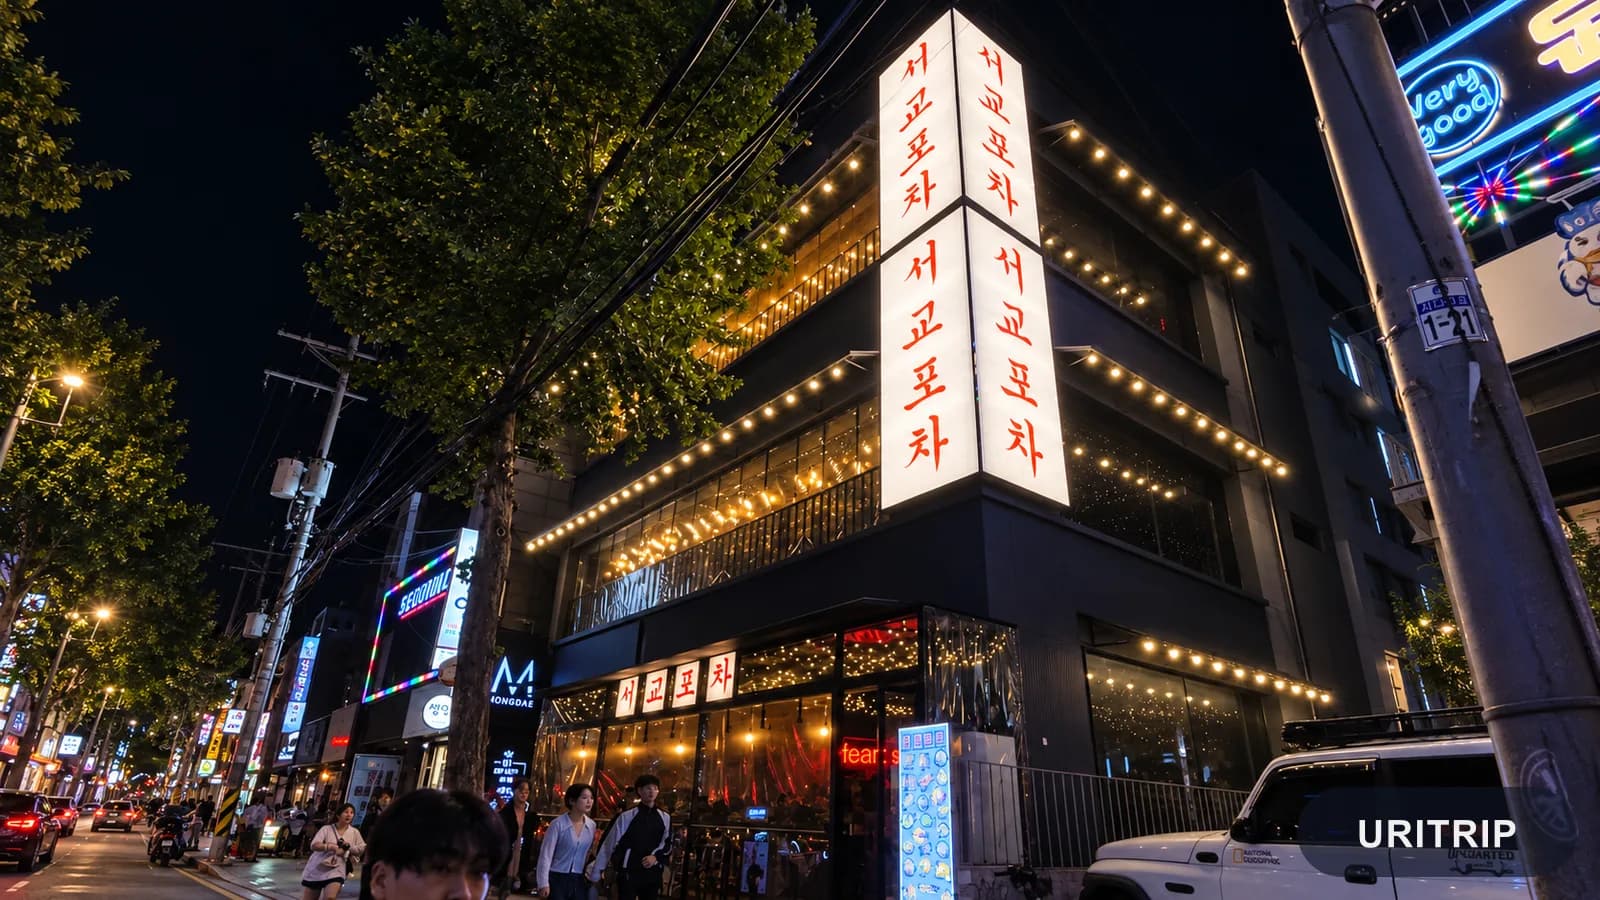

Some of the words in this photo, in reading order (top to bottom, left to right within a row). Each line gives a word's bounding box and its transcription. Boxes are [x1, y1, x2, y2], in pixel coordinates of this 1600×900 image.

[899, 42, 937, 217] 서교포차
[978, 46, 1019, 216] 서교포차
[902, 239, 949, 471] 서교포차
[994, 246, 1044, 478] 서교포차
[620, 657, 732, 709] 서교포차
